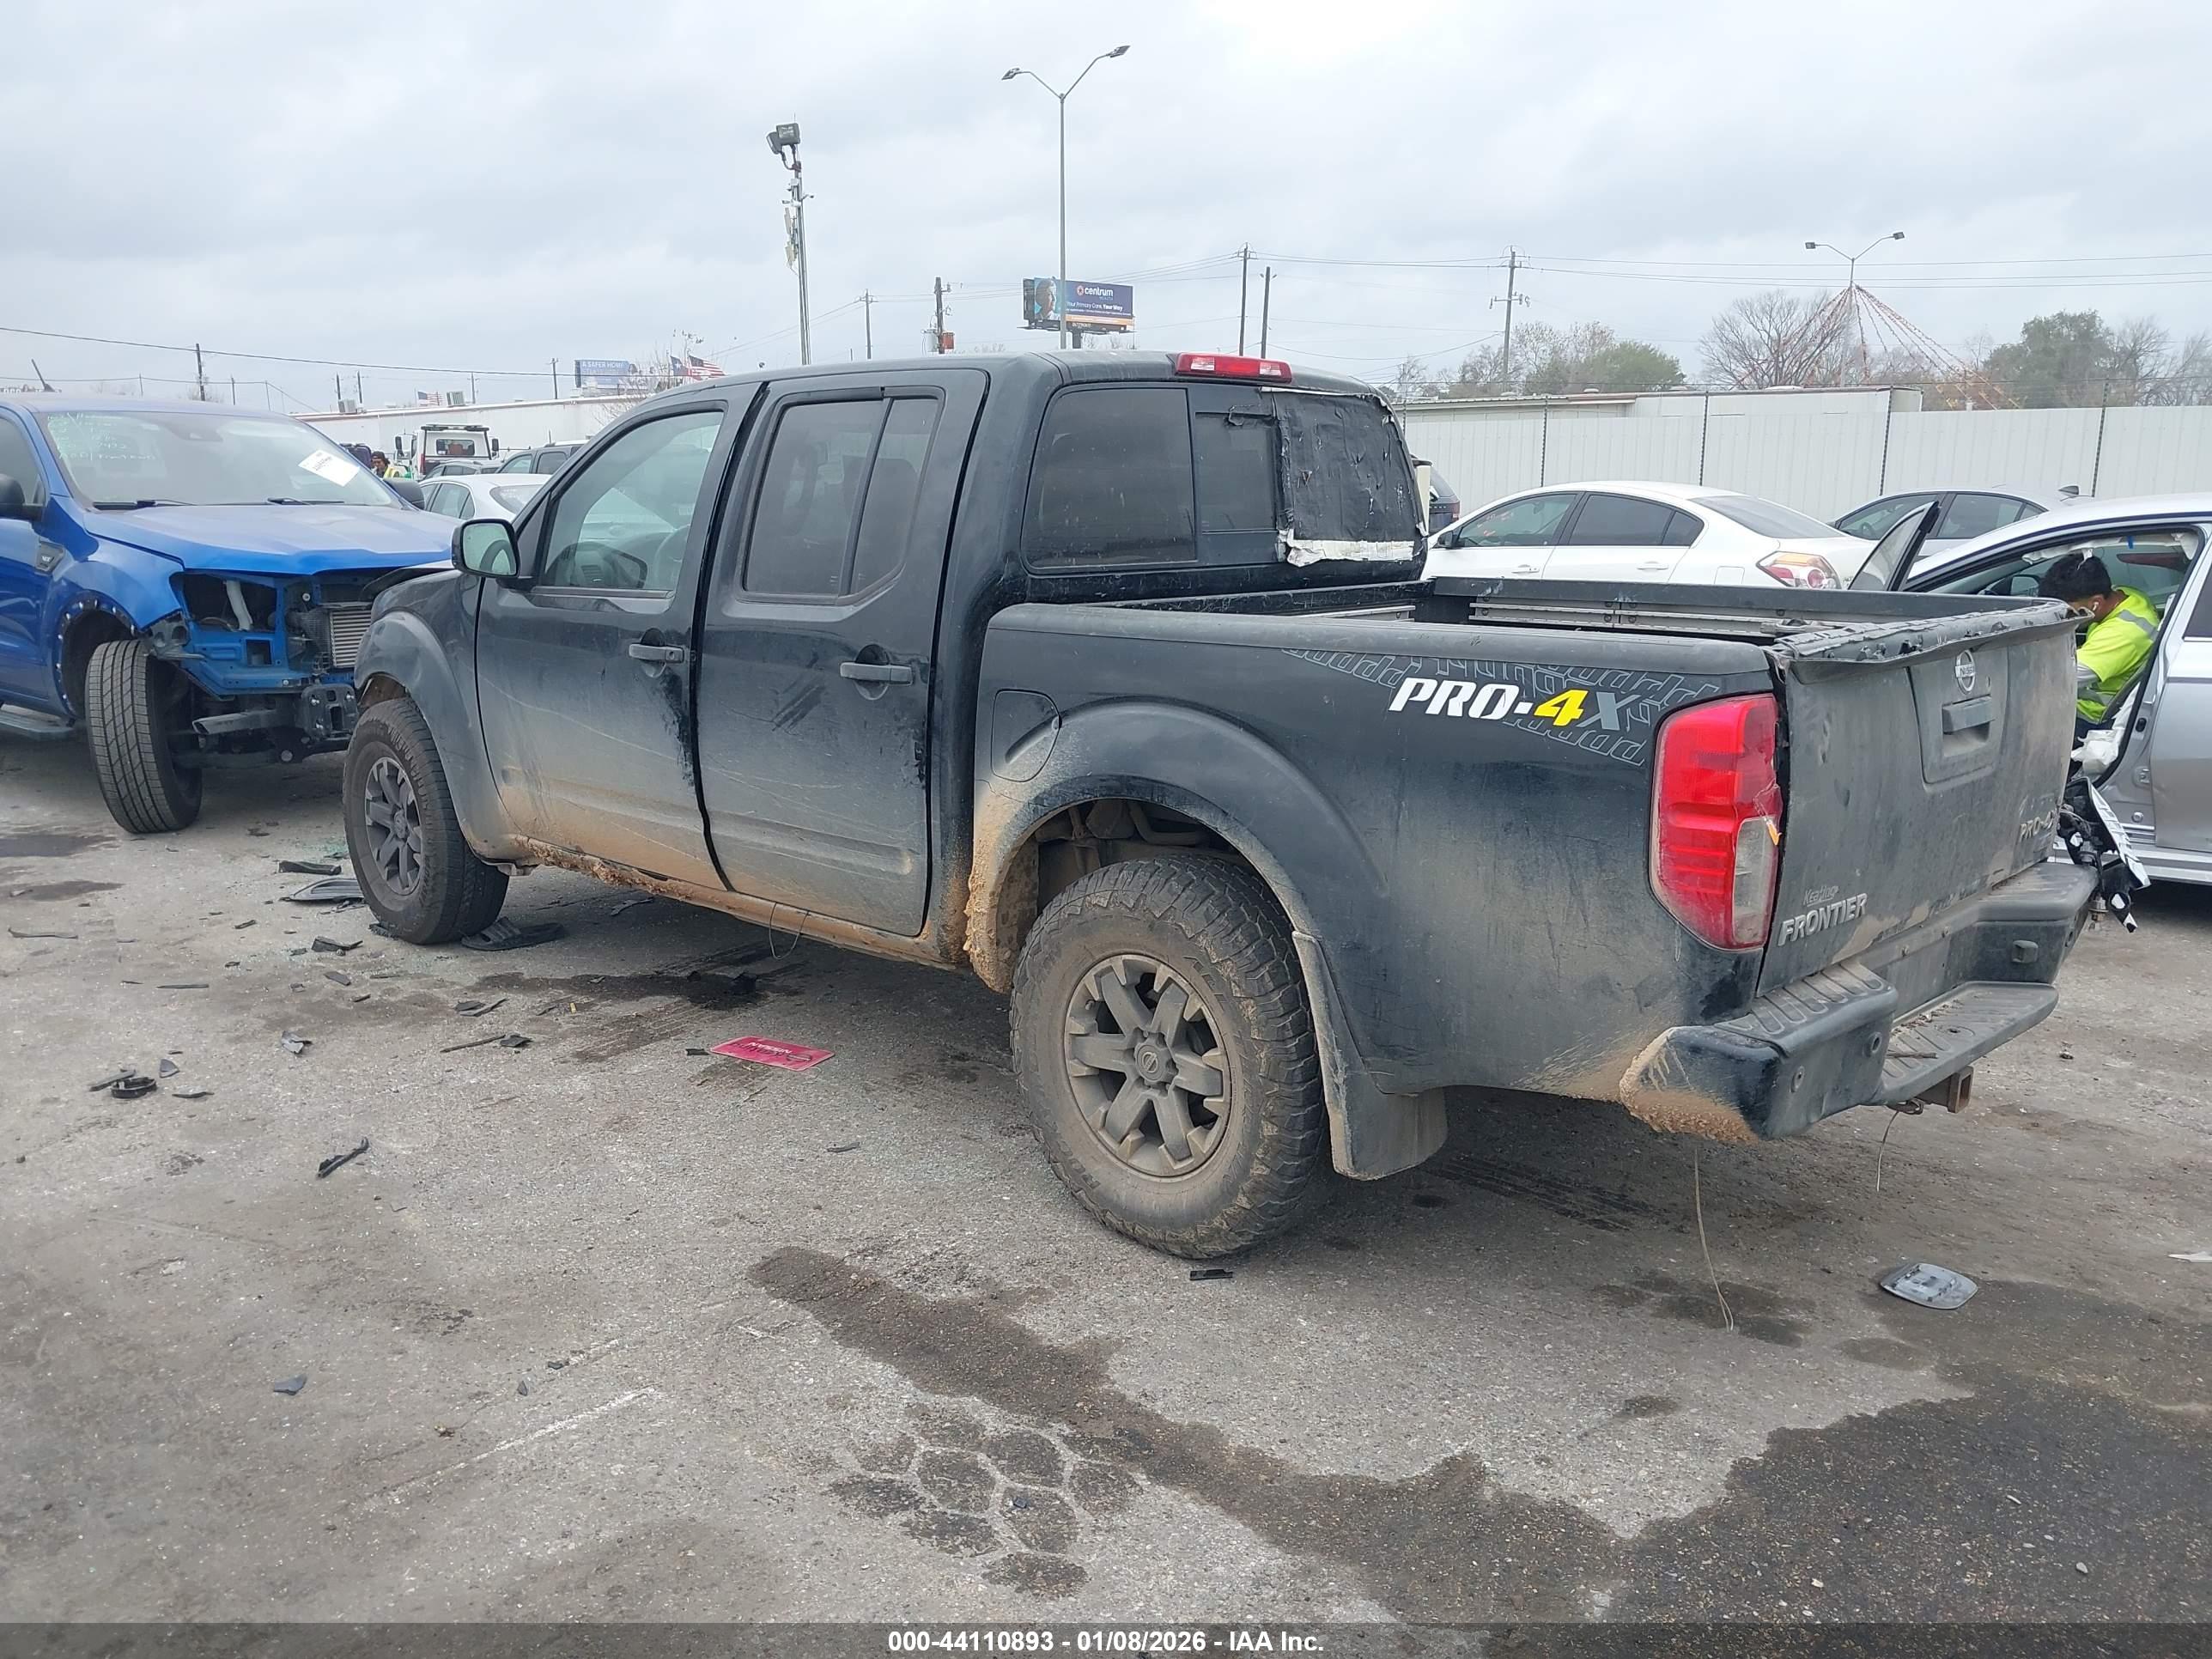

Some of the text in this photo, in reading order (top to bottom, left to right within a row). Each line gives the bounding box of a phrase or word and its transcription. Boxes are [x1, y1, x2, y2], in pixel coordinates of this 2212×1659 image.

[1085, 287, 1114, 296] centrum
[1389, 677, 1640, 731] PRO-4X
[1778, 892, 1868, 946] FRONTIER
[748, 1042, 792, 1053] NISSAN
